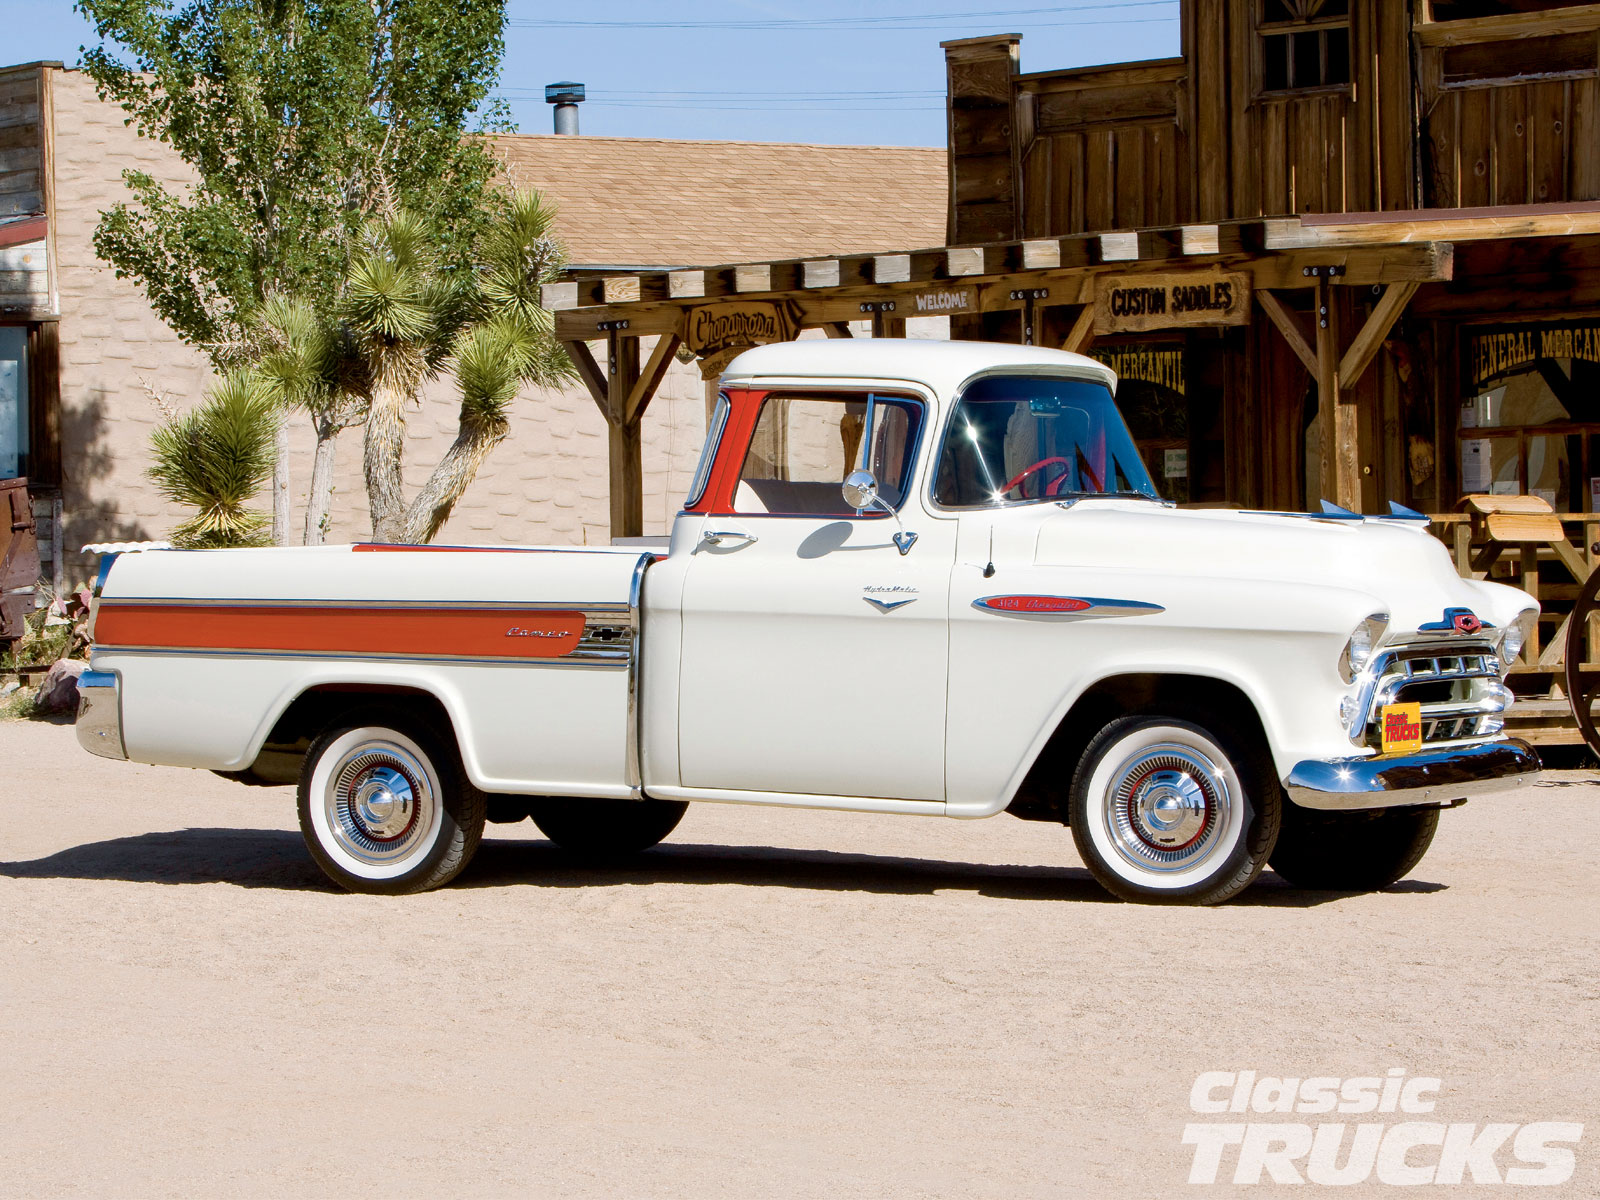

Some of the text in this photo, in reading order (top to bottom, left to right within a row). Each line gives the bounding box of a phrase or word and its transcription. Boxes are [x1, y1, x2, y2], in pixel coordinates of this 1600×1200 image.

[916, 291, 968, 311] WELCOME
[1111, 281, 1233, 317] CUSTOM SADDLES
[1472, 331, 1536, 384] GENERAL
[997, 599, 1080, 609] 3124 Chevrolet
[504, 627, 574, 639] Cameo
[1386, 712, 1408, 725] Classic
[1385, 723, 1419, 742] TRUCKS
